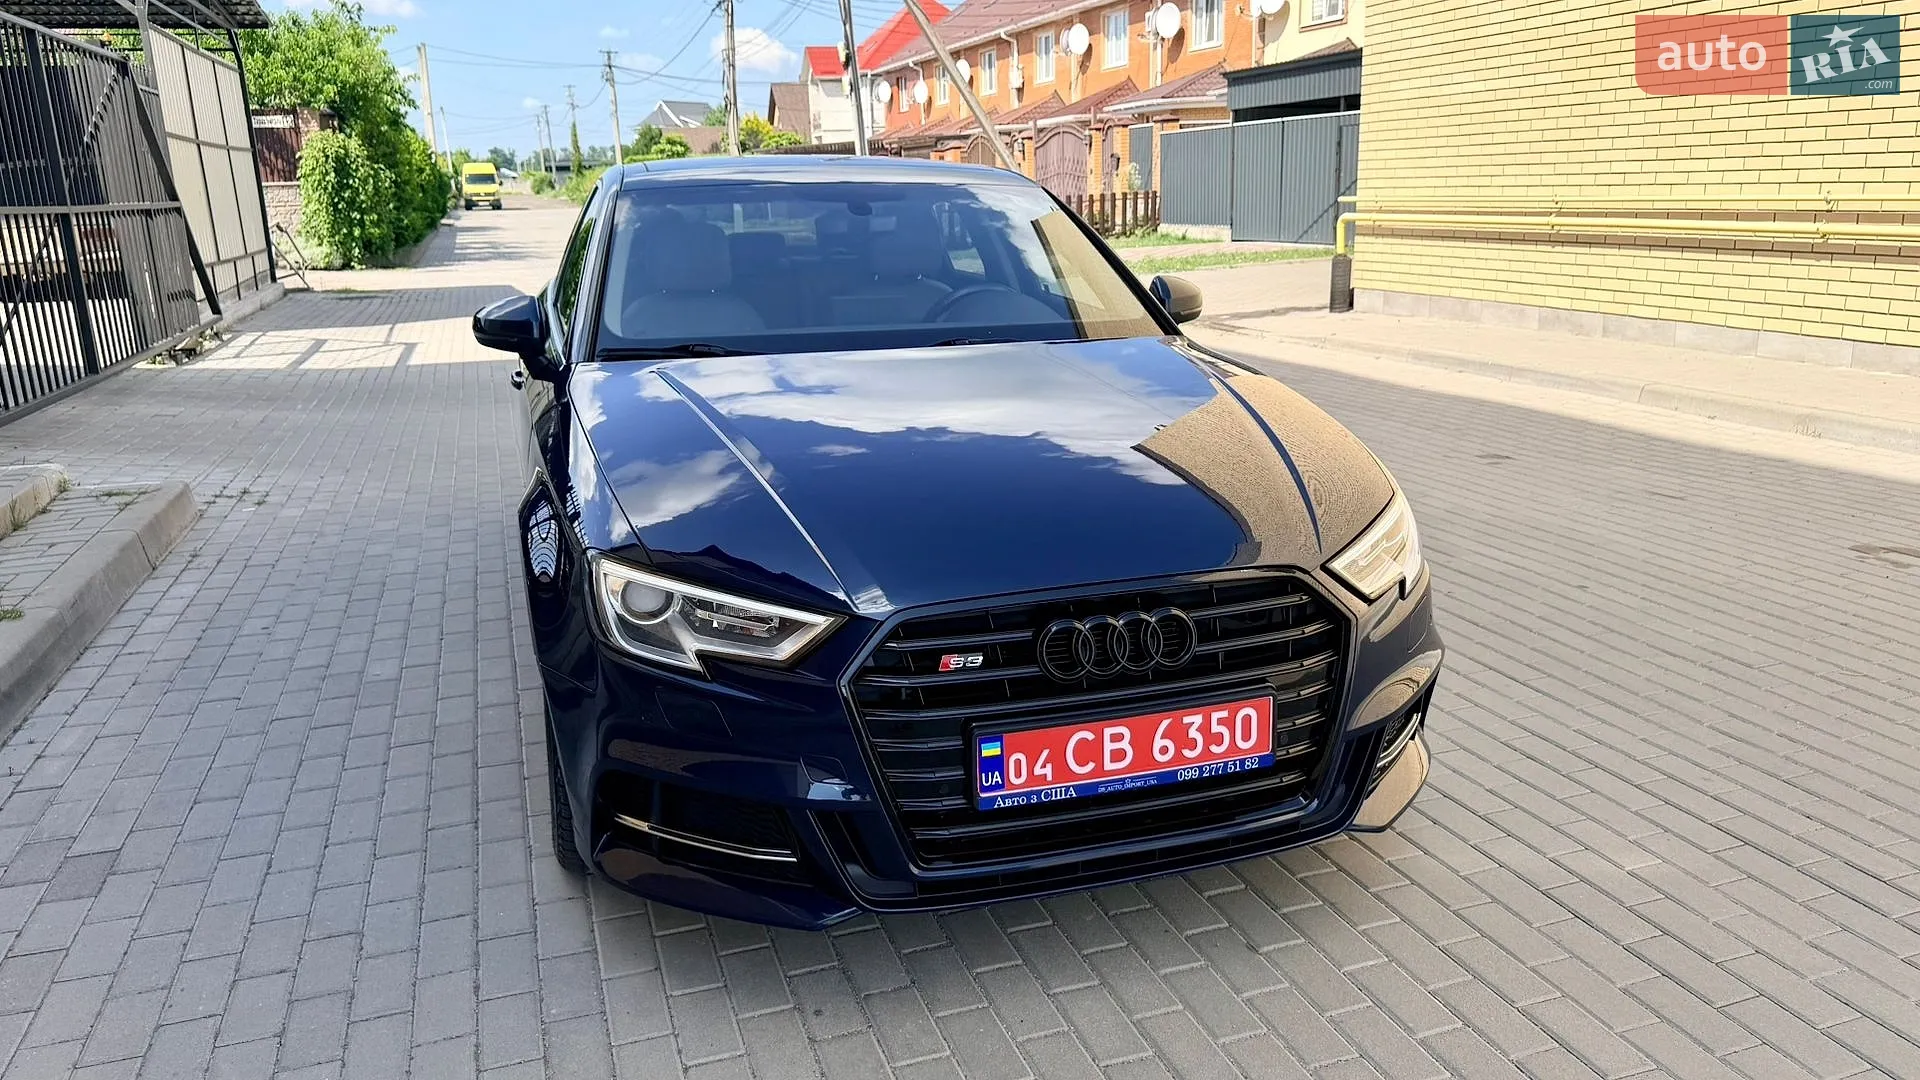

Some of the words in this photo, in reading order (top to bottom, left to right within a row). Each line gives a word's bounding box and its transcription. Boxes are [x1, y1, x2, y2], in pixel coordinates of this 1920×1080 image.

[1008, 748, 1053, 785] 04
[1065, 725, 1134, 775] CB
[1152, 706, 1258, 763] 6350
[981, 771, 1002, 787] UA
[1177, 767, 1199, 781] 099
[1202, 763, 1224, 777] 277
[1227, 760, 1241, 773] 51
[1244, 757, 1259, 770] 82
[1041, 786, 1077, 802] США
